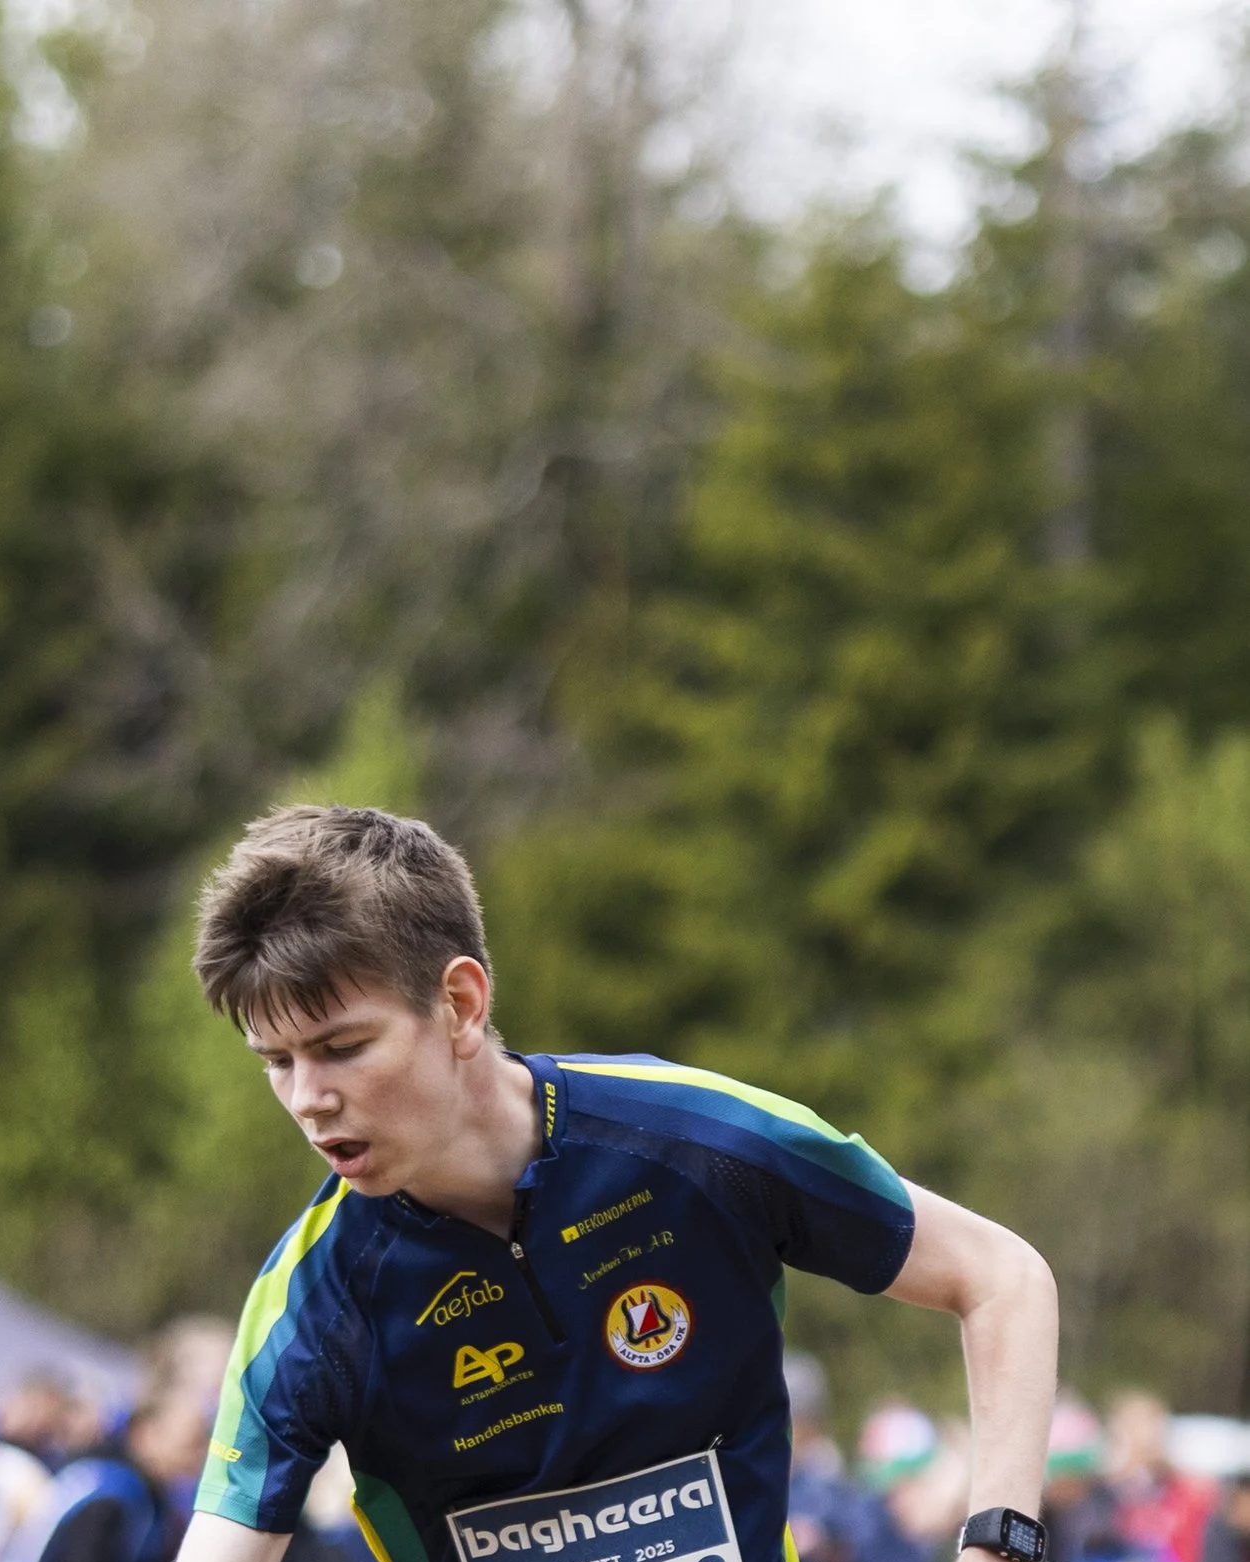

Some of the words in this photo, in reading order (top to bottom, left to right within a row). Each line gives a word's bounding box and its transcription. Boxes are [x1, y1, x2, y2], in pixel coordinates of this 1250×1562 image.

[577, 1189, 654, 1236] REKONOMERNA
[434, 1279, 504, 1326] aefab
[453, 1342, 525, 1389] AP
[461, 1370, 535, 1406] ALFTAPRODUKTER
[454, 1402, 565, 1452] Handelsbanken
[464, 1478, 713, 1559] bagheera
[635, 1539, 675, 1562] 2025
